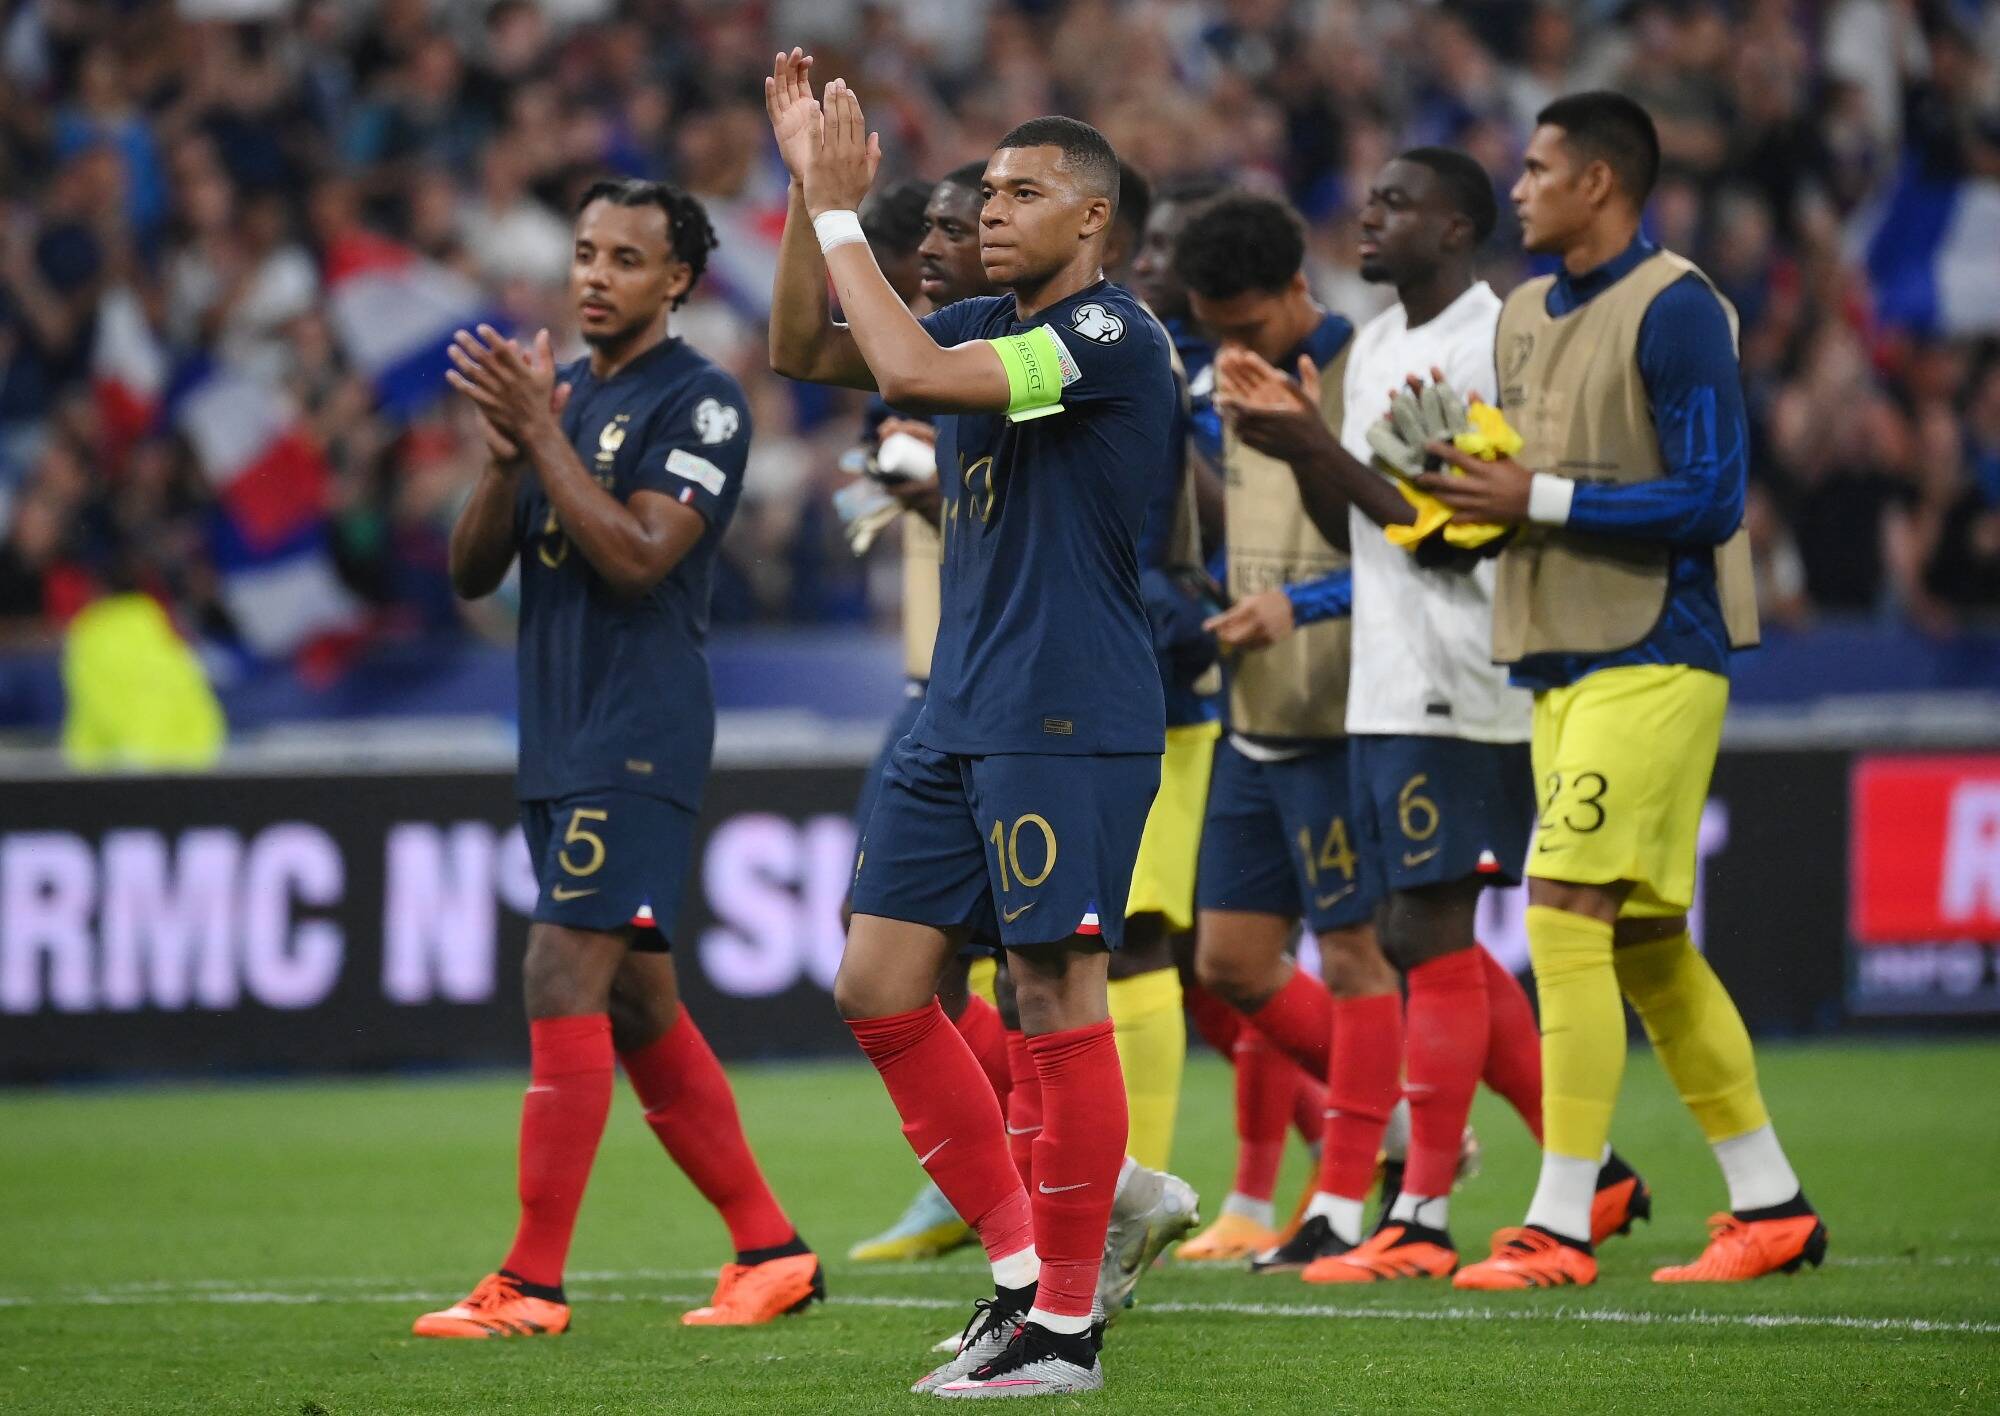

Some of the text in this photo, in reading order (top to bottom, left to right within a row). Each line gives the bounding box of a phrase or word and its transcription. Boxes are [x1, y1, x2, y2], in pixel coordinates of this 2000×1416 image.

[1016, 341, 1041, 391] RESPECT
[1398, 773, 1440, 841] 6
[1539, 771, 1608, 834] 23
[558, 808, 608, 877] 5
[989, 812, 1057, 892] 10
[1297, 814, 1359, 888] 14
[0, 820, 346, 1015] RMC
